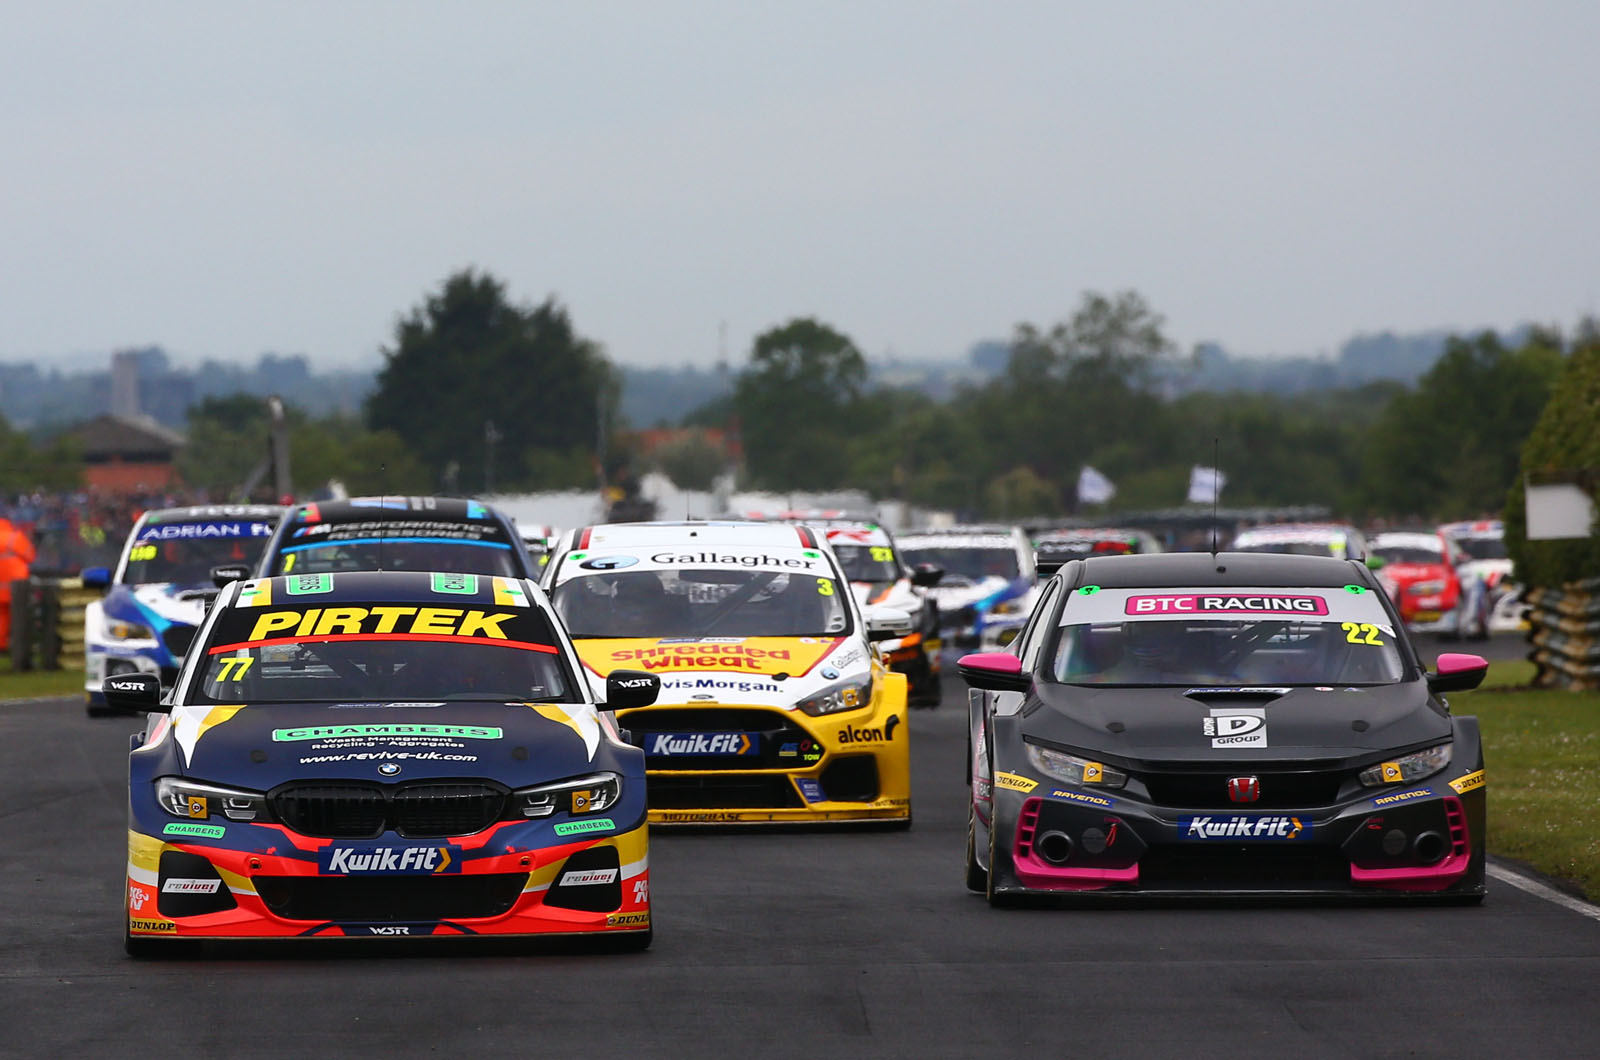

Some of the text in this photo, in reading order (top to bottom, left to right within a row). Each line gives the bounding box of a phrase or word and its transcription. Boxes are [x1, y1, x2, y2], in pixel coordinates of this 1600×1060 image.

[143, 524, 240, 539] ADRIAN
[282, 553, 296, 573] 1
[651, 552, 816, 569] Gallagher
[817, 578, 834, 596] 3
[1135, 597, 1314, 611] BTC RACING
[247, 607, 518, 641] PIRTEK
[1341, 622, 1384, 646] 22
[216, 657, 255, 682] 77
[111, 682, 145, 691] WSR
[618, 679, 653, 689] WSR
[663, 679, 783, 693] visMorgan.
[287, 727, 489, 737] CHAMBERS
[838, 725, 883, 743] alcon
[311, 741, 375, 749] Recycling
[389, 740, 465, 748] Aggregates
[1217, 736, 1260, 744] GROUP
[300, 751, 478, 764] www.revive-uk.com
[997, 776, 1033, 788] DUNLOP
[1053, 790, 1111, 805] RAVENOL
[1375, 789, 1431, 805] RAVENOL
[167, 825, 221, 836] CHAMBERS
[558, 821, 611, 833] CHAMBERS
[130, 921, 175, 930] DUNLOP
[369, 927, 409, 935] WSR
